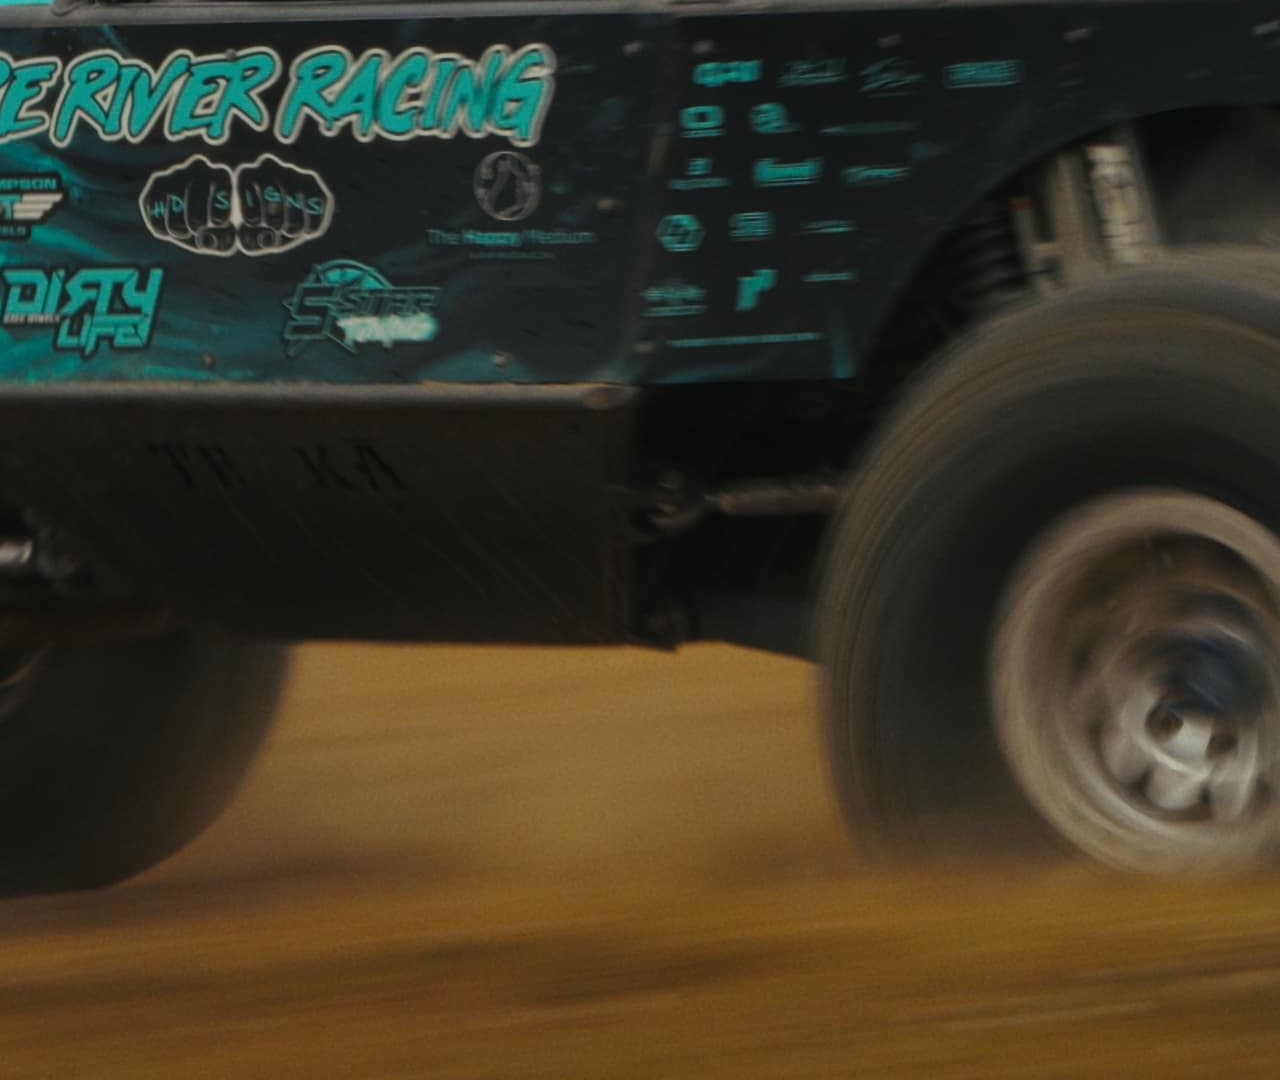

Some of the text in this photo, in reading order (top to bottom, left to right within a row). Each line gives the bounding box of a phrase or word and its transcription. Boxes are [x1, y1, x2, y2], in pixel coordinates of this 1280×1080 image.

[51, 48, 280, 146] RIVER
[275, 45, 554, 147] RACING
[2, 268, 164, 317] DIRTY
[56, 314, 151, 356] LIFE
